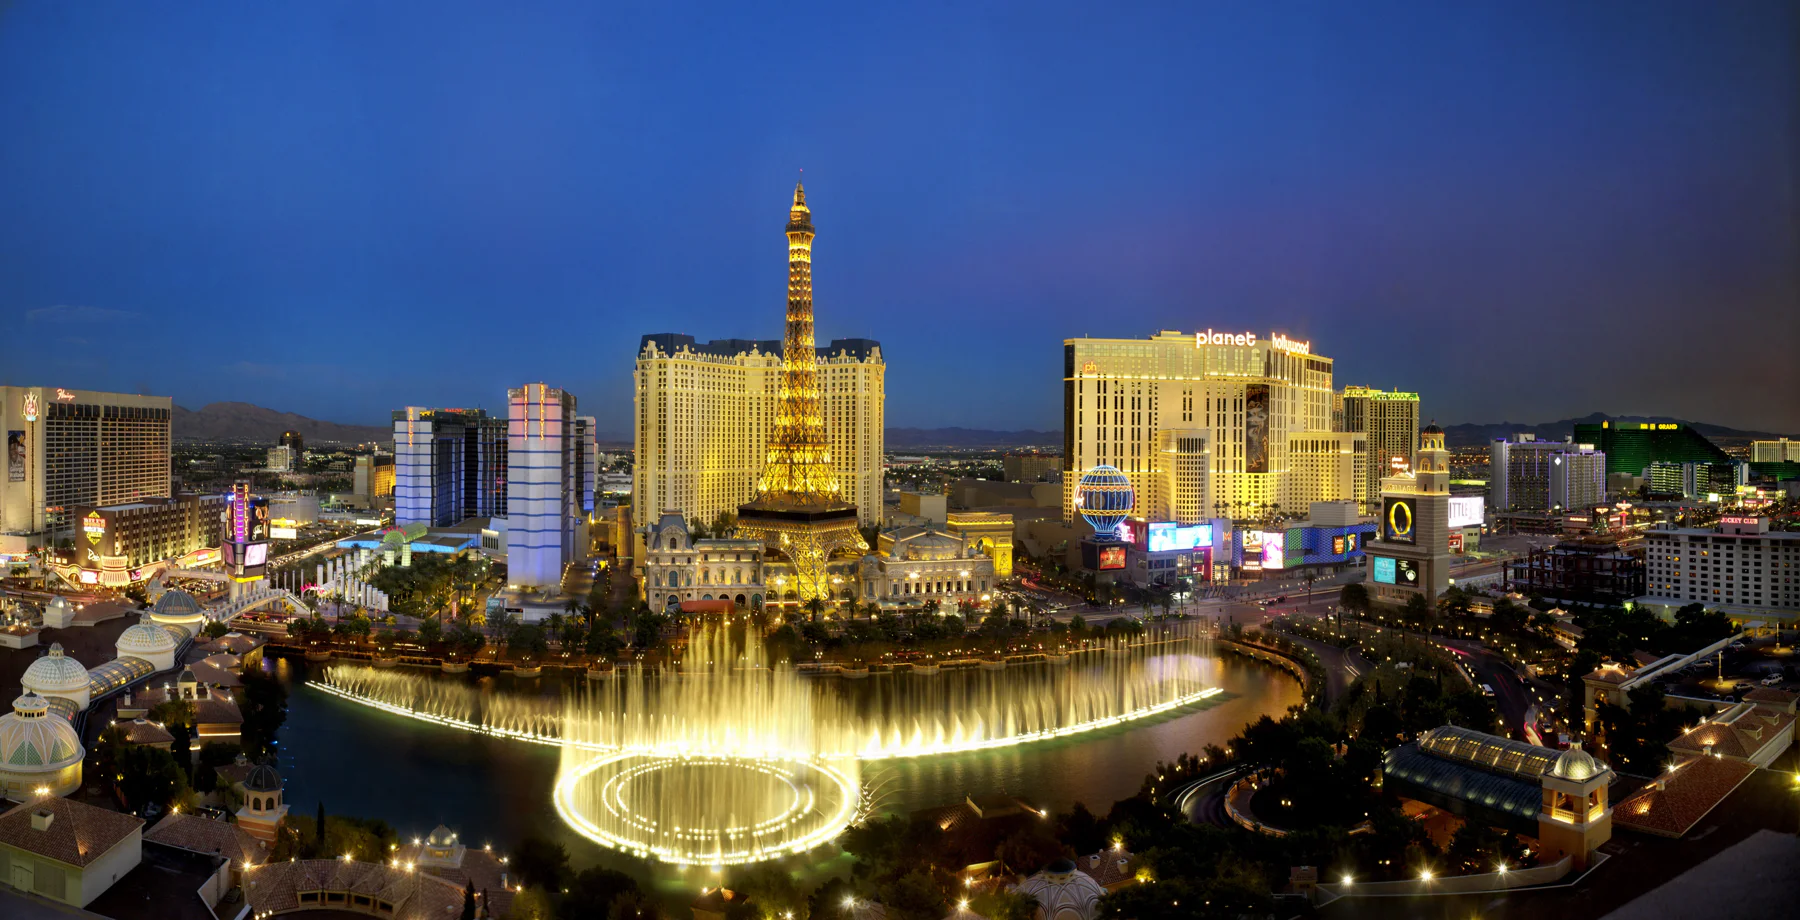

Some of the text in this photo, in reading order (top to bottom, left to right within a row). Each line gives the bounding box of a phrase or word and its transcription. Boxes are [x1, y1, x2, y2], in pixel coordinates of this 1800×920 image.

[1196, 328, 1256, 348] planet
[1272, 332, 1309, 356] hollywood
[1085, 361, 1097, 373] ph
[1658, 423, 1678, 431] GRAND
[1389, 501, 1412, 535] O
[1449, 502, 1468, 519] ITTLE
